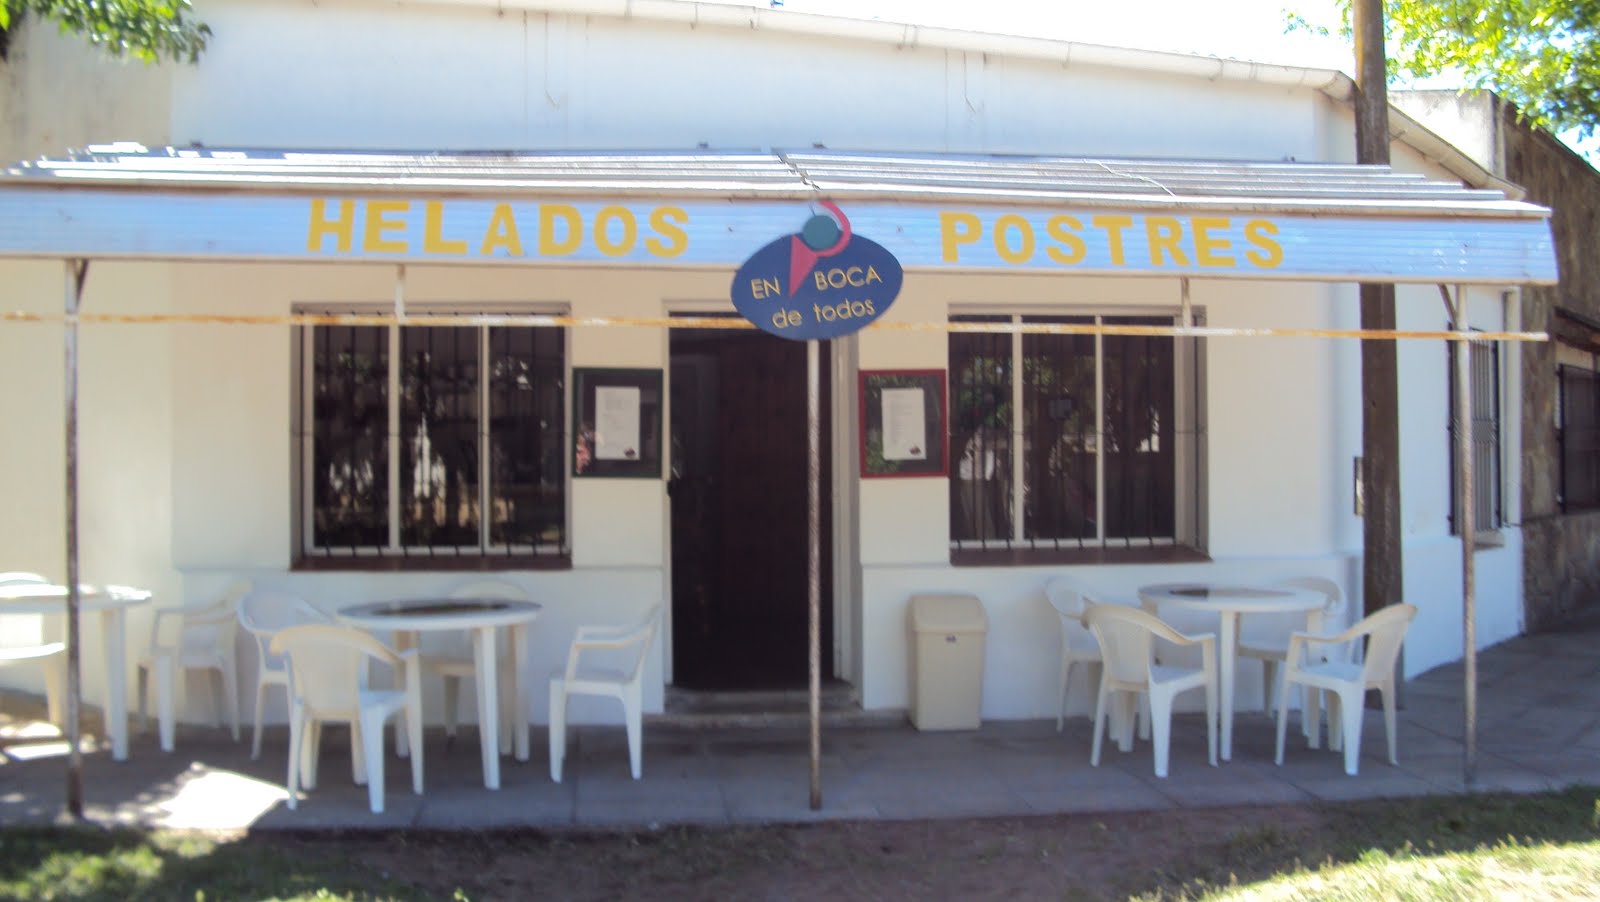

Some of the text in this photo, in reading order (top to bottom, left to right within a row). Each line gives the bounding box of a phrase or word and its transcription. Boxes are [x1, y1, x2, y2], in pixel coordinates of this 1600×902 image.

[306, 197, 690, 259] HELADOS
[938, 211, 1285, 269] POSTRES
[751, 264, 884, 300] EN BOCA
[772, 298, 876, 329] de todos
